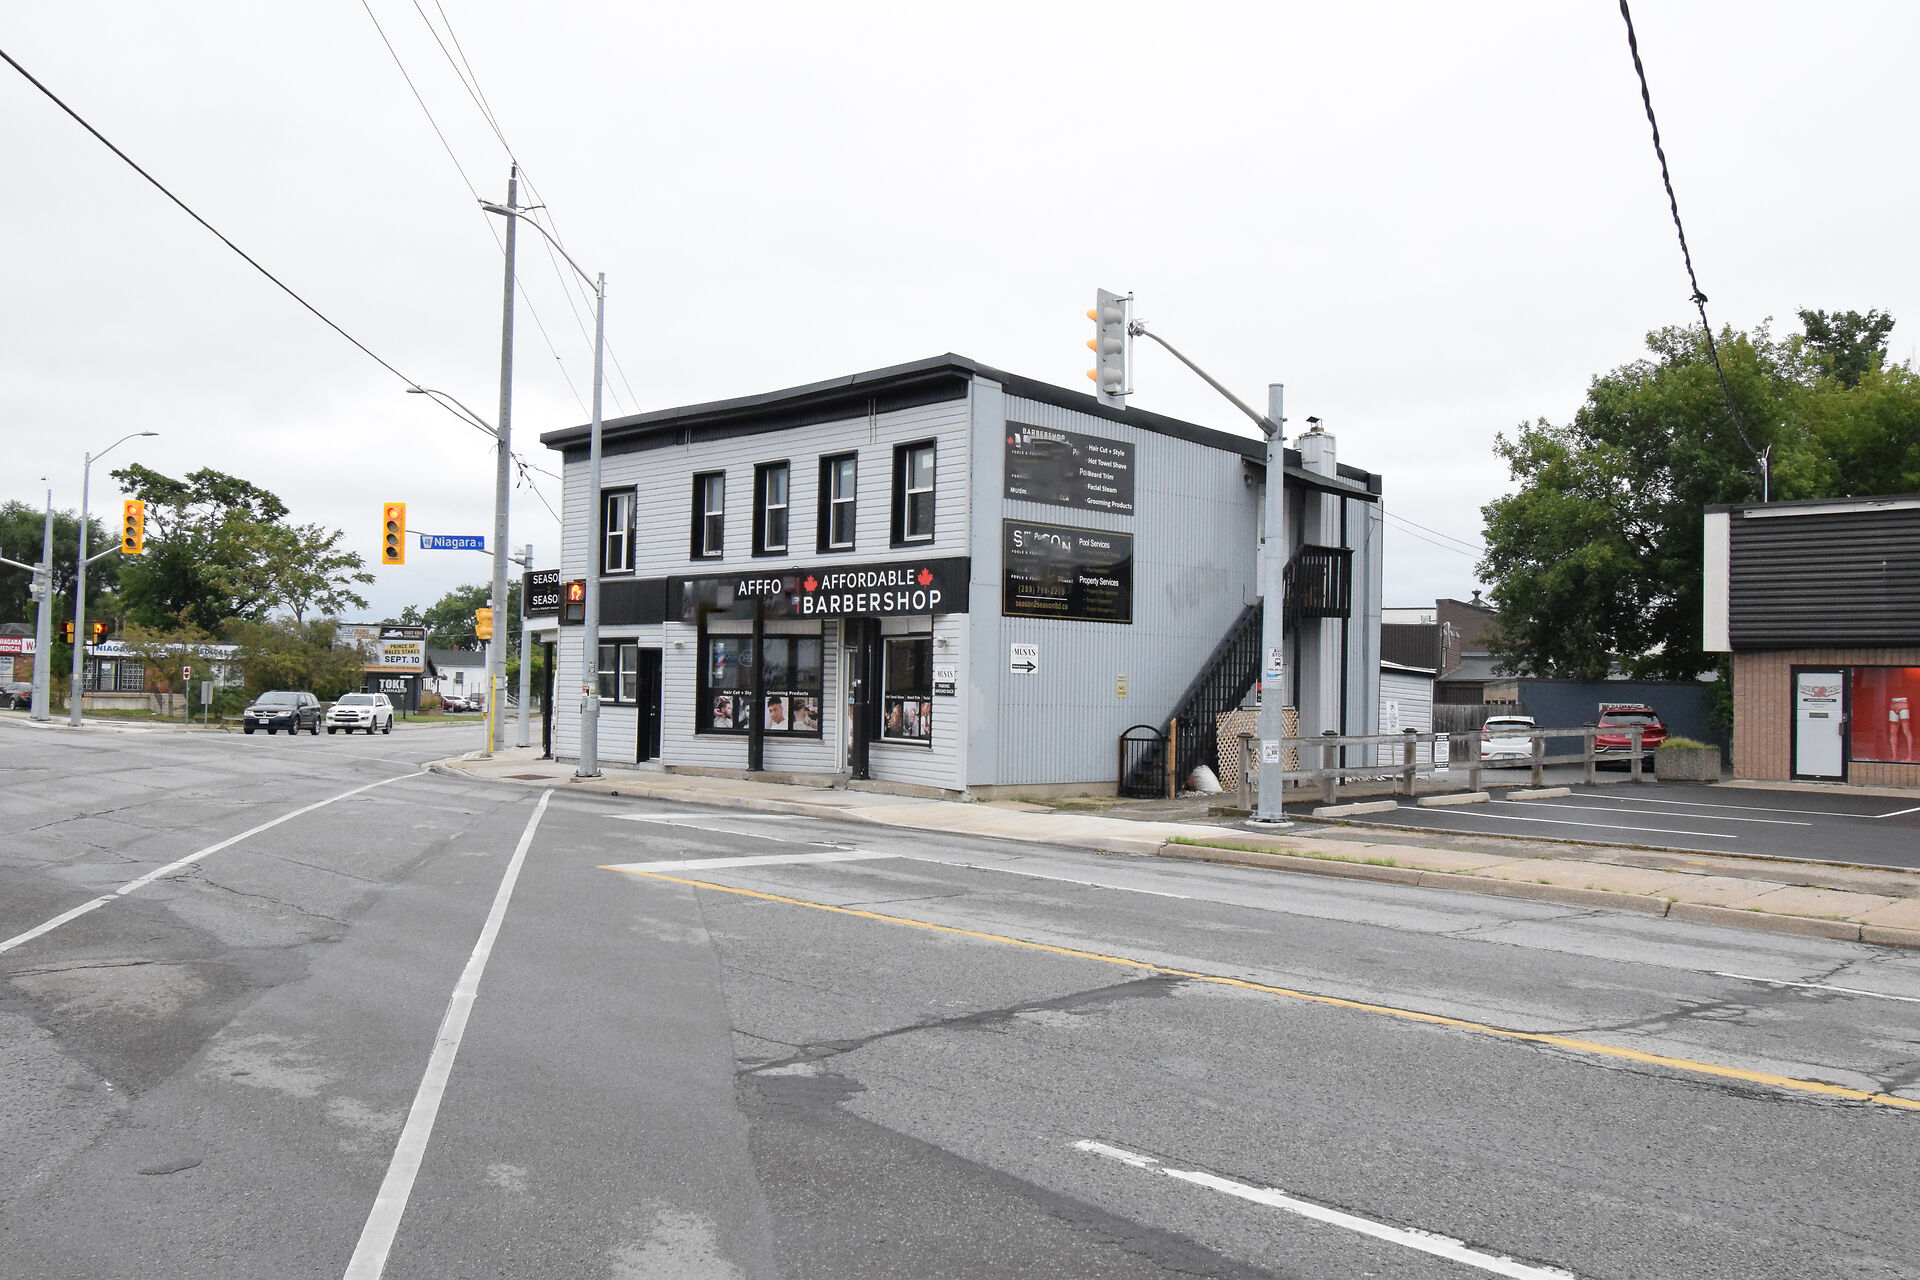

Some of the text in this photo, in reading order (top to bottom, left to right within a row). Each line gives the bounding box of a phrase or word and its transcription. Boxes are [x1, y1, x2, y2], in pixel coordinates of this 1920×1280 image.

[1088, 444, 1099, 452] Hair
[1112, 447, 1125, 457] Style
[1087, 457, 1127, 470] Hot Towel Shave
[1087, 471, 1102, 479] Beard
[1102, 472, 1114, 480] Trim
[1087, 483, 1117, 493] Facial Steam
[1086, 497, 1132, 510] Grooming Products
[434, 536, 477, 550] Niagara
[1079, 538, 1110, 549] Pool Services
[738, 569, 915, 596] AFFFO AFFORDABLE
[1079, 576, 1099, 587] Property
[1099, 577, 1119, 587] Services
[532, 594, 560, 605] SEASO
[803, 589, 942, 614] BARBERSHOP
[384, 655, 420, 664] SEPT. 10
[379, 679, 405, 689] TOKE
